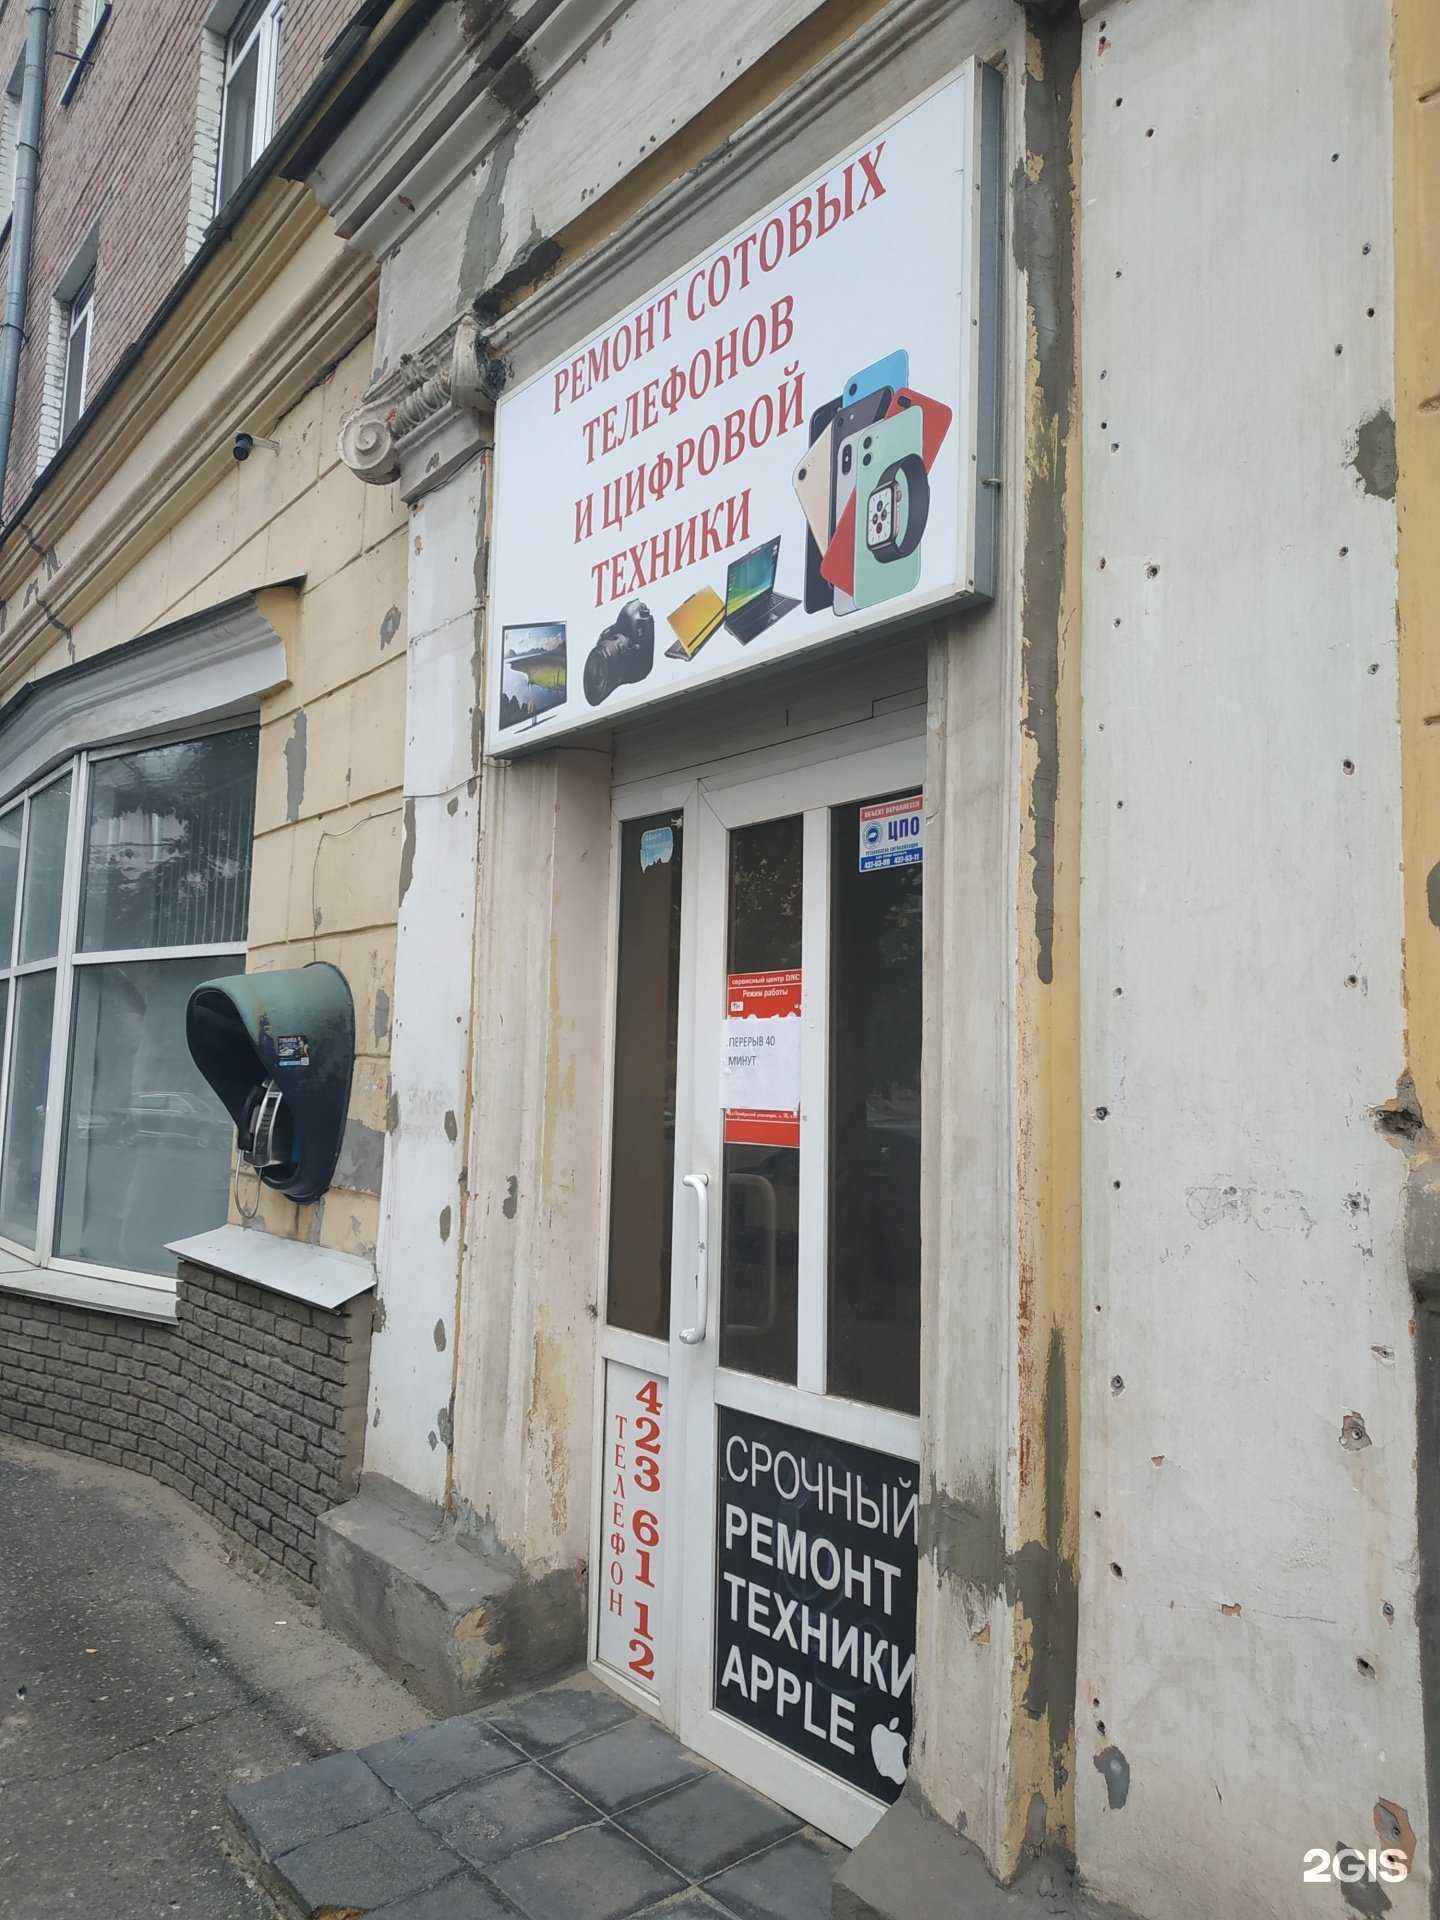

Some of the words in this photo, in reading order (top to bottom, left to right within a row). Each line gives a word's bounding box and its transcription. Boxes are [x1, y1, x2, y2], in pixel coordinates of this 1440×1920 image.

[553, 290, 677, 415] РЕМОНТ
[686, 141, 887, 321] СОТОВЫХ
[583, 295, 794, 464] ТЕЛЕФОНОВ
[574, 492, 594, 544] И
[601, 360, 806, 532] ЦИФРОВОЙ
[591, 488, 751, 608] ТЕХНИКИ
[888, 816, 920, 841] ЦПО
[728, 1035, 764, 1047] ПЕРЕРЫВ
[765, 1035, 776, 1046] 40
[728, 1055, 757, 1067] МИНУТ
[608, 1414, 628, 1618] ТЕЛЕФОН
[725, 1434, 918, 1546] СРОЧНЫЙ
[725, 1503, 901, 1616] РЕМОНТ
[723, 1571, 916, 1699] ТЕХНИКИ
[720, 1645, 856, 1756] APPLE
